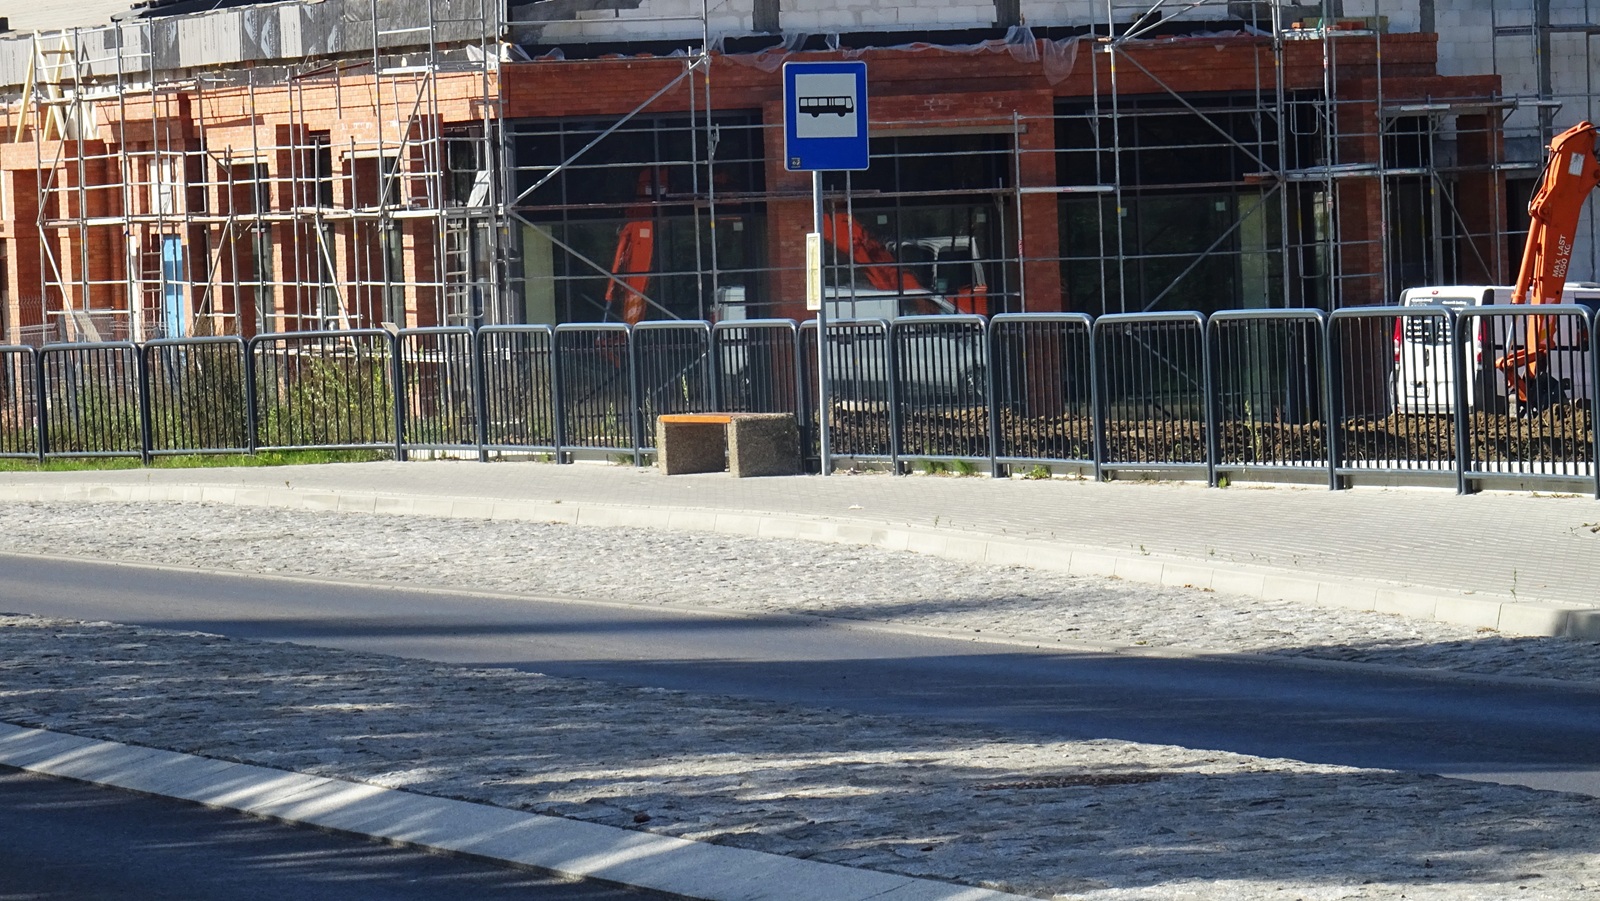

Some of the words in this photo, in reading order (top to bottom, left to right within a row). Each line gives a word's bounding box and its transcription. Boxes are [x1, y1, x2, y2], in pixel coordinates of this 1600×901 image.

[1552, 259, 1561, 277] MAX
[1557, 234, 1566, 255] LAST
[1559, 258, 1567, 277] 1050
[1563, 244, 1571, 255] KG
